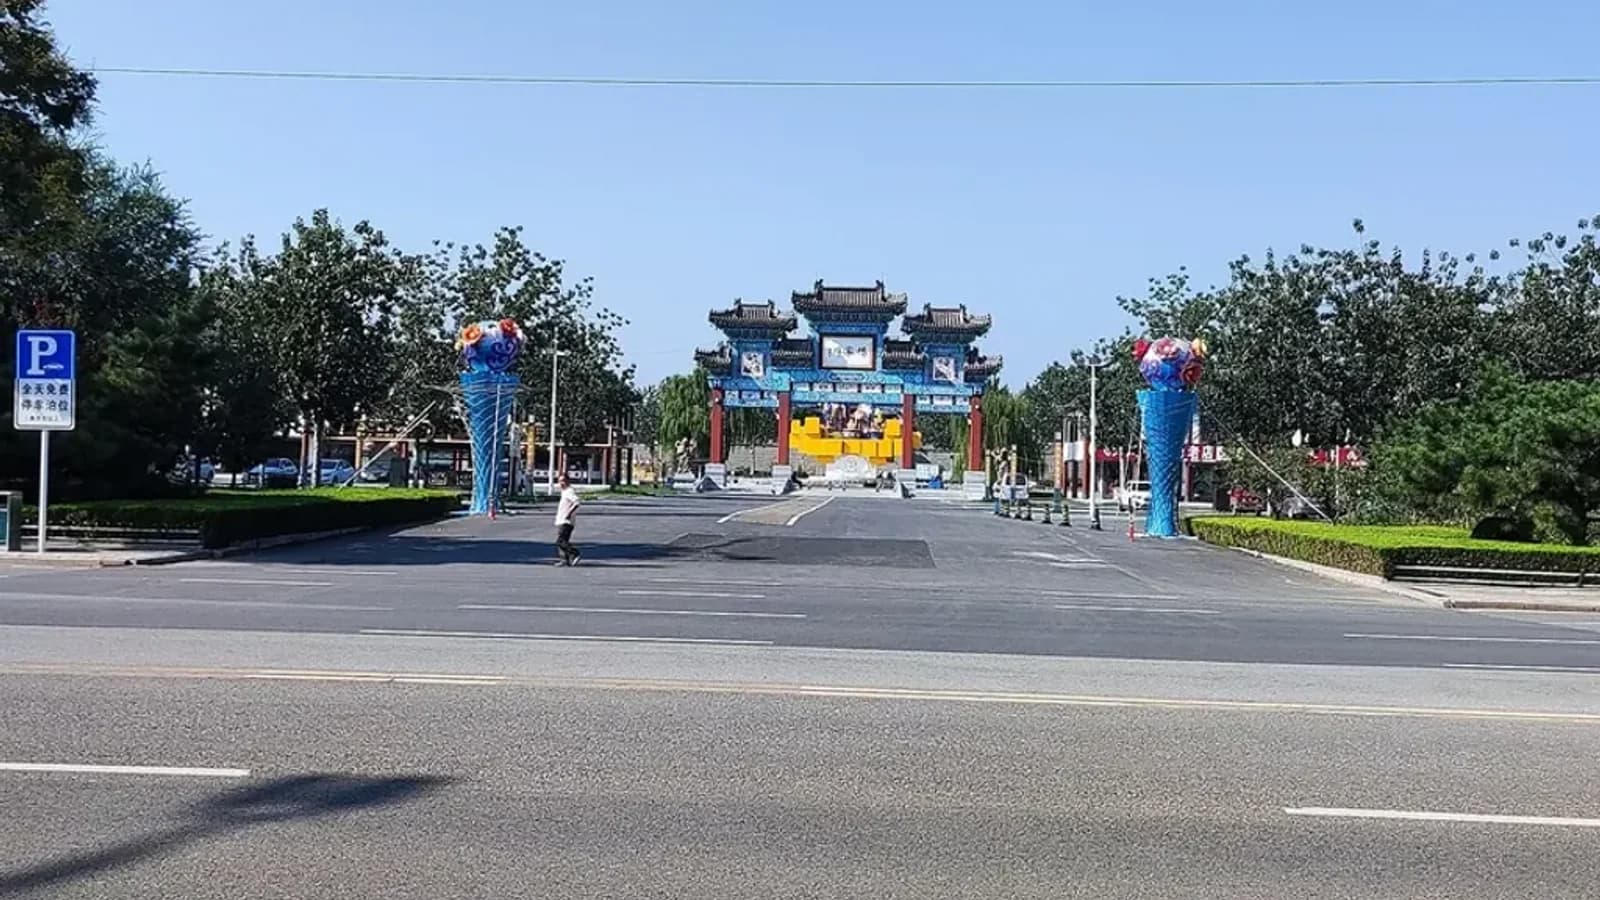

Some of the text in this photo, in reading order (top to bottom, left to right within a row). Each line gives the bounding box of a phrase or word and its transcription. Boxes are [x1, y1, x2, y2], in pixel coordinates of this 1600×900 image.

[27, 336, 57, 375] P
[23, 383, 68, 394] 全天免费
[22, 400, 68, 411] 停车泊位
